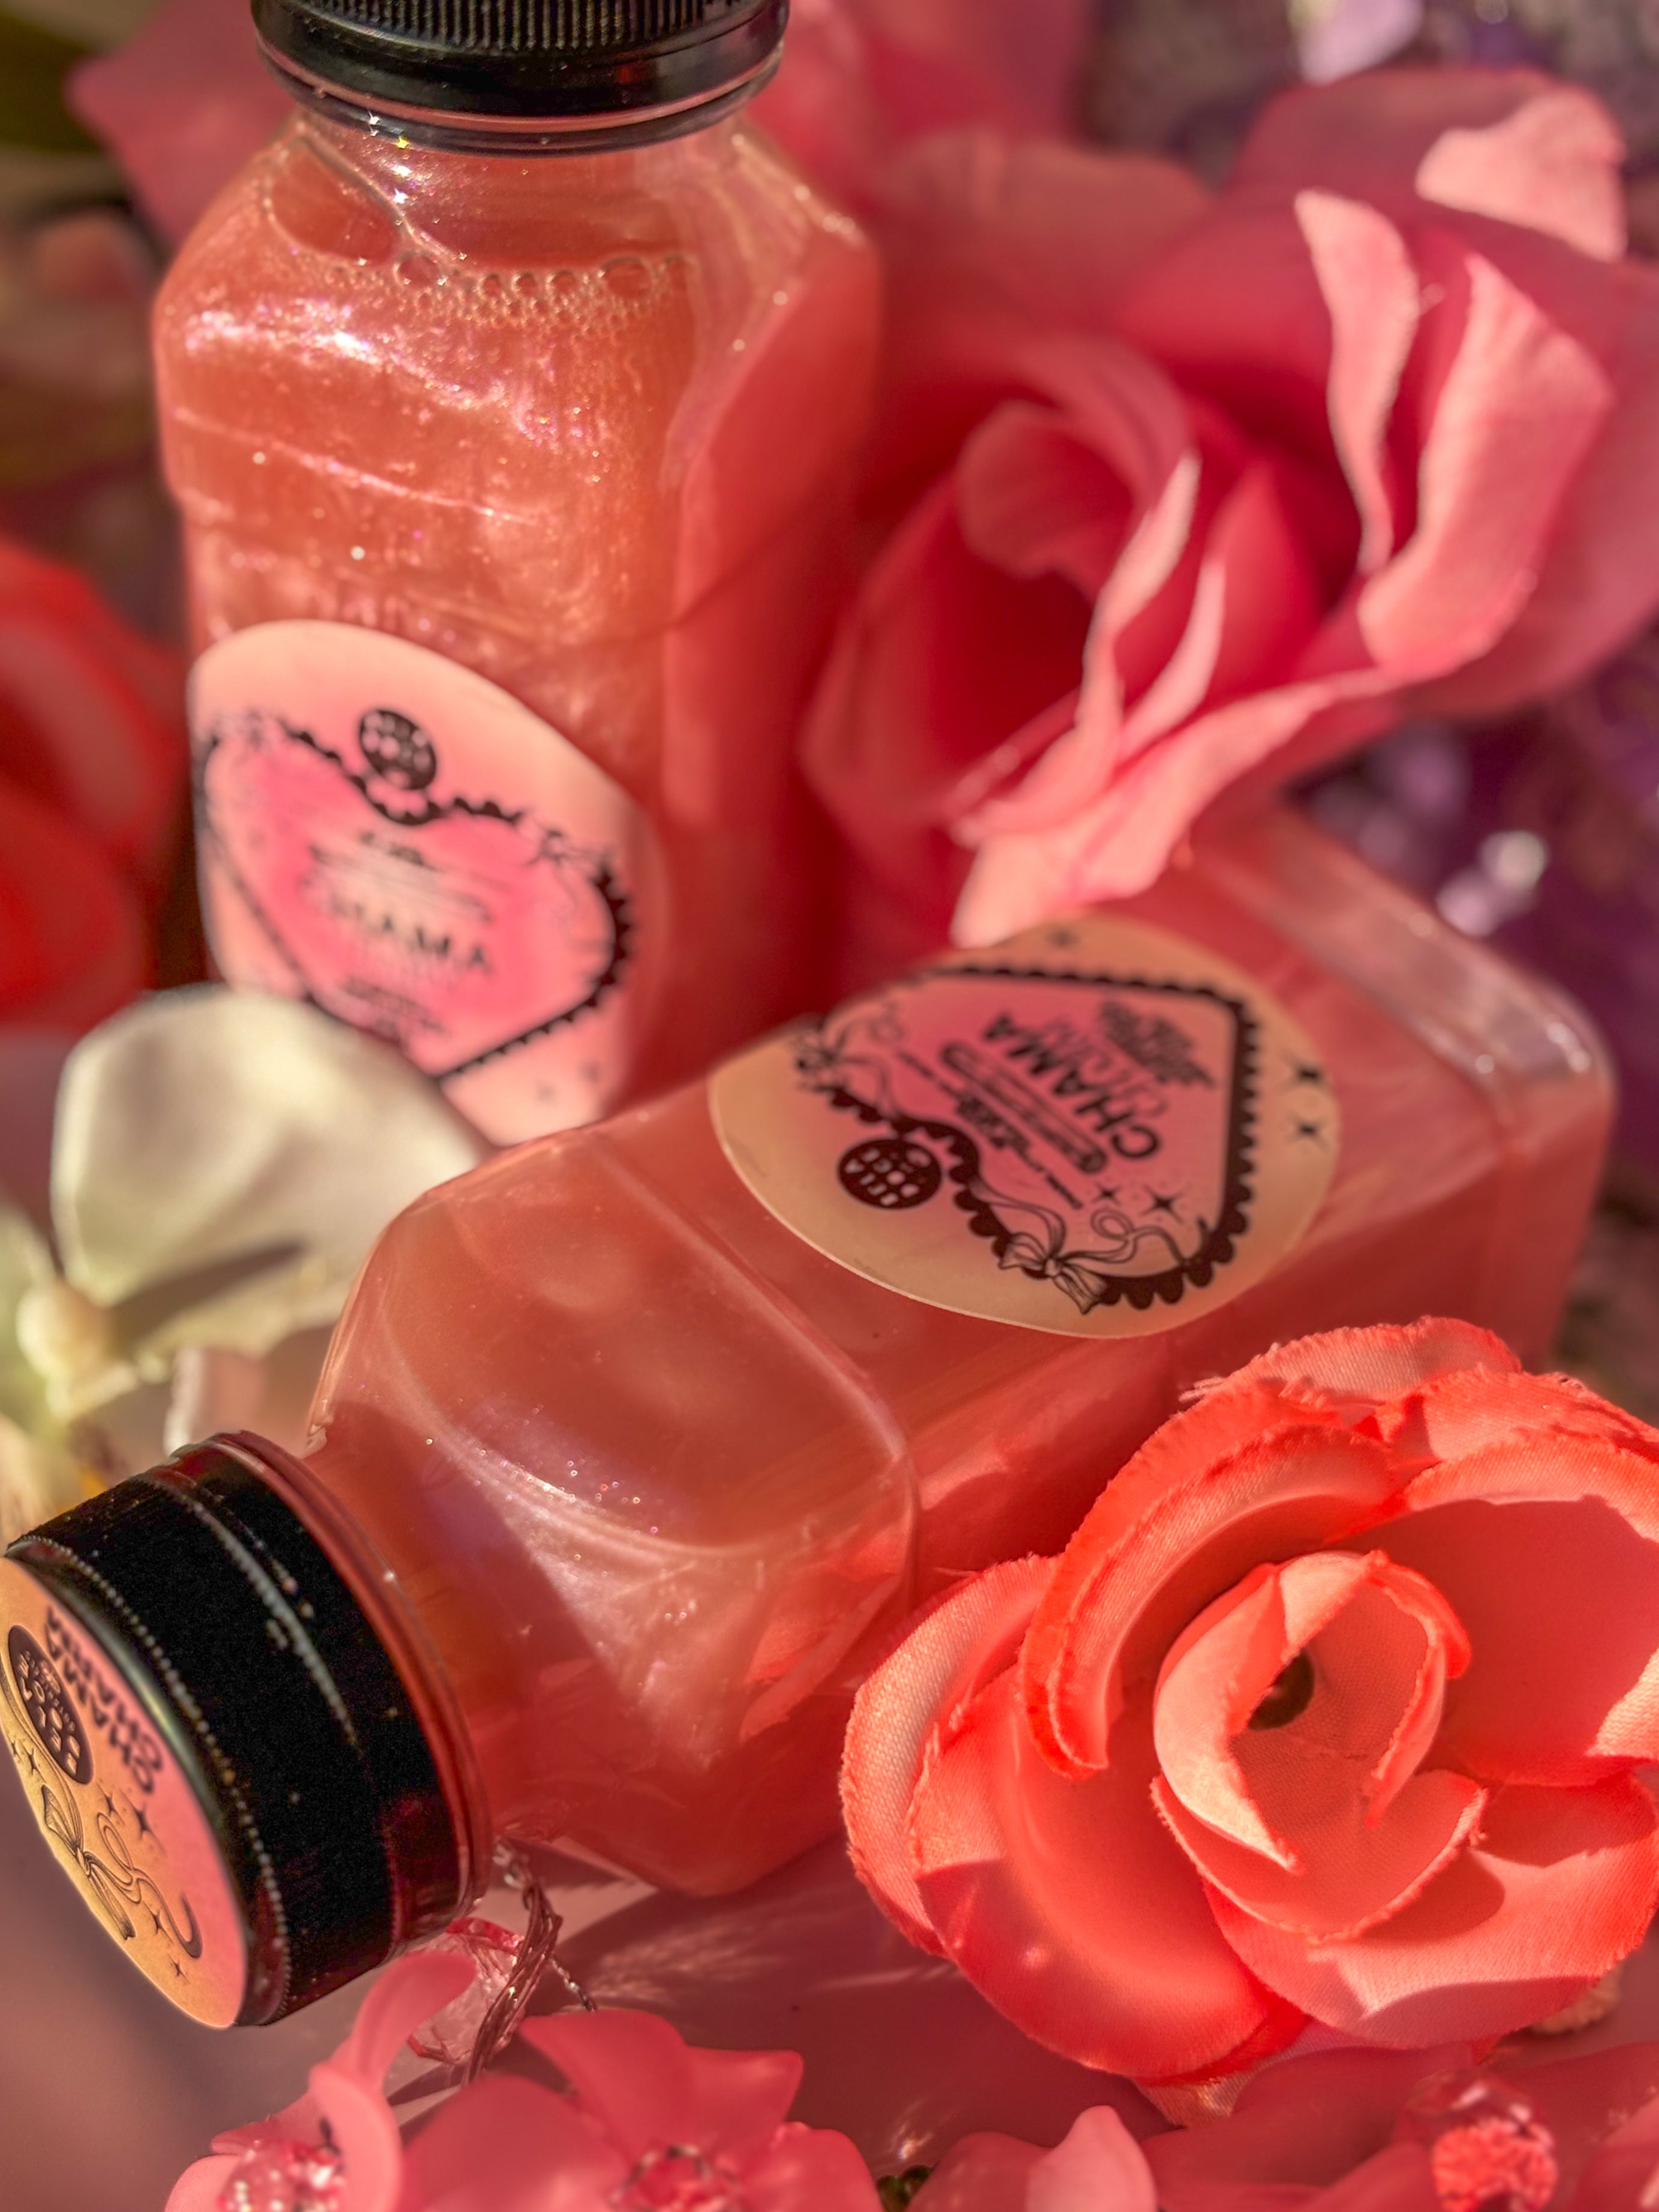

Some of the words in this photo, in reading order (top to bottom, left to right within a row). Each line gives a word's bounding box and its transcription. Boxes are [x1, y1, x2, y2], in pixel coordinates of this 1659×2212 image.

[985, 1015, 1160, 1160] CHAMA
[19, 1653, 80, 1759] DOCE
[20, 1677, 77, 1776] BELA
[45, 1622, 154, 1794] CHAMA
